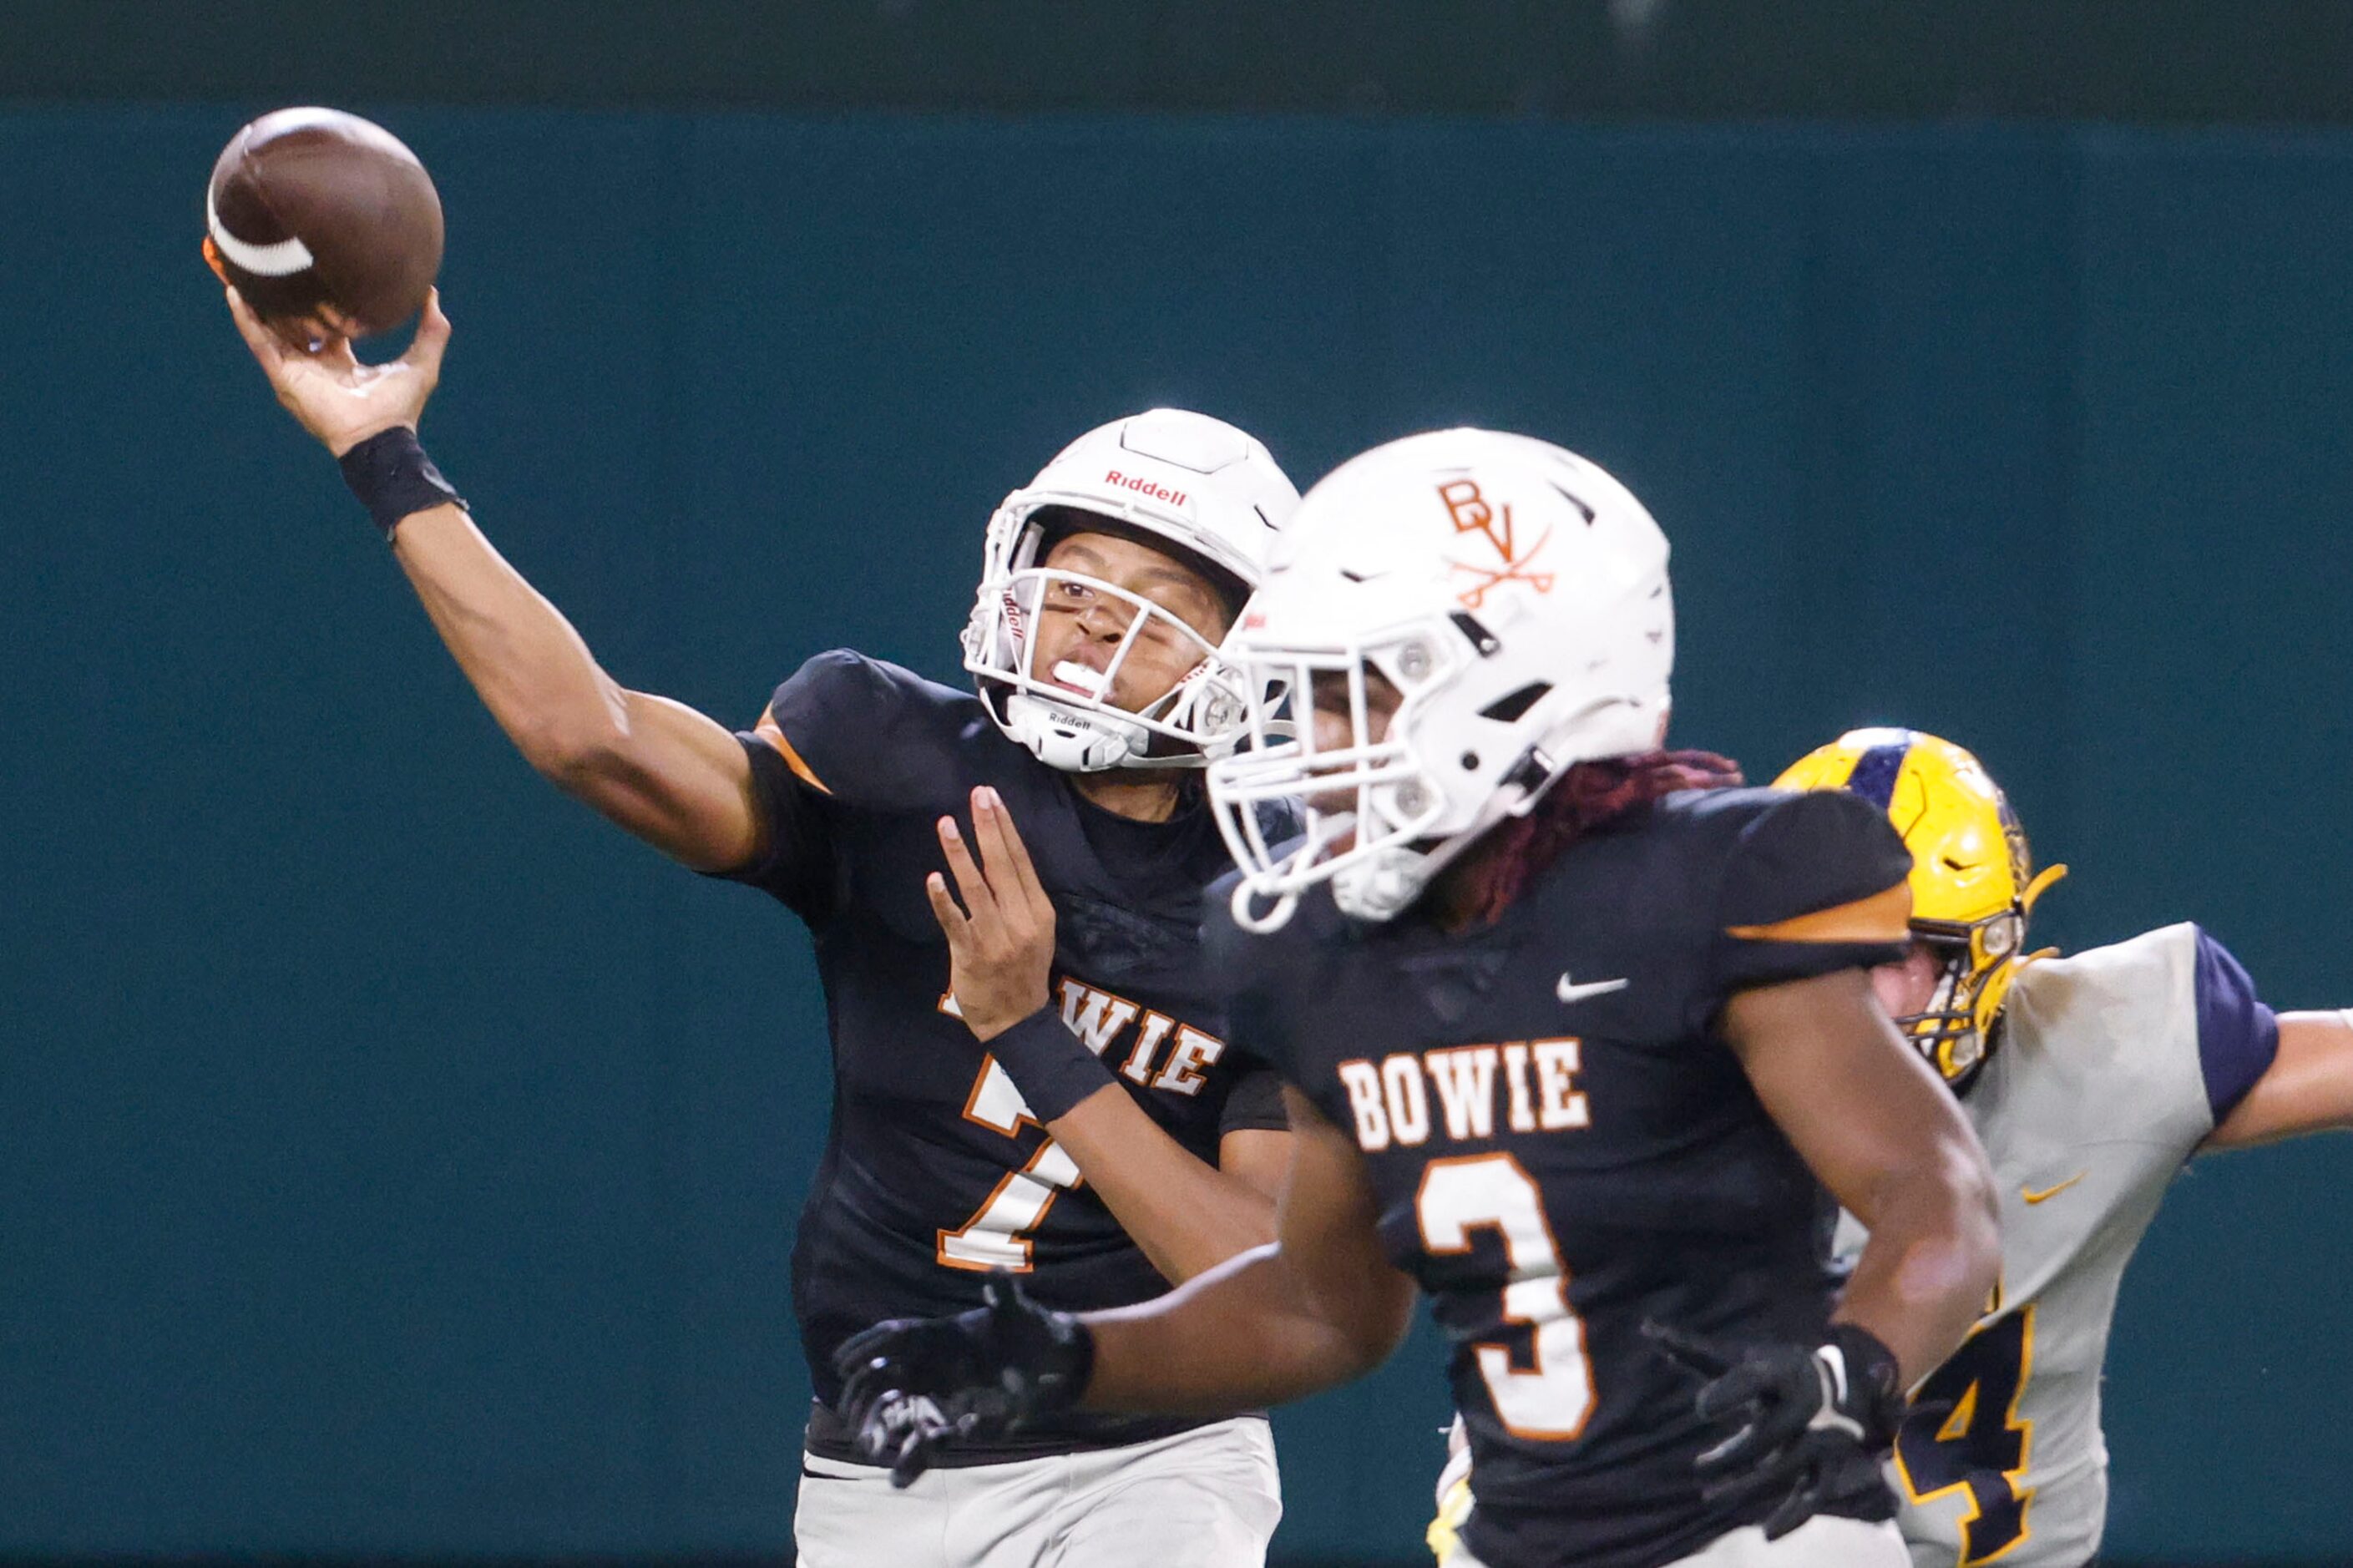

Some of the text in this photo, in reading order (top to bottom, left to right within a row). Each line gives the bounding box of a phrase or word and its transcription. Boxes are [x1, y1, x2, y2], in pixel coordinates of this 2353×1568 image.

[1106, 470, 1187, 506] Riddell
[1003, 587, 1023, 639] iddell
[1049, 712, 1090, 730] Riddell
[1338, 1037, 1590, 1151] BOWIE
[1414, 1151, 1598, 1441] 3
